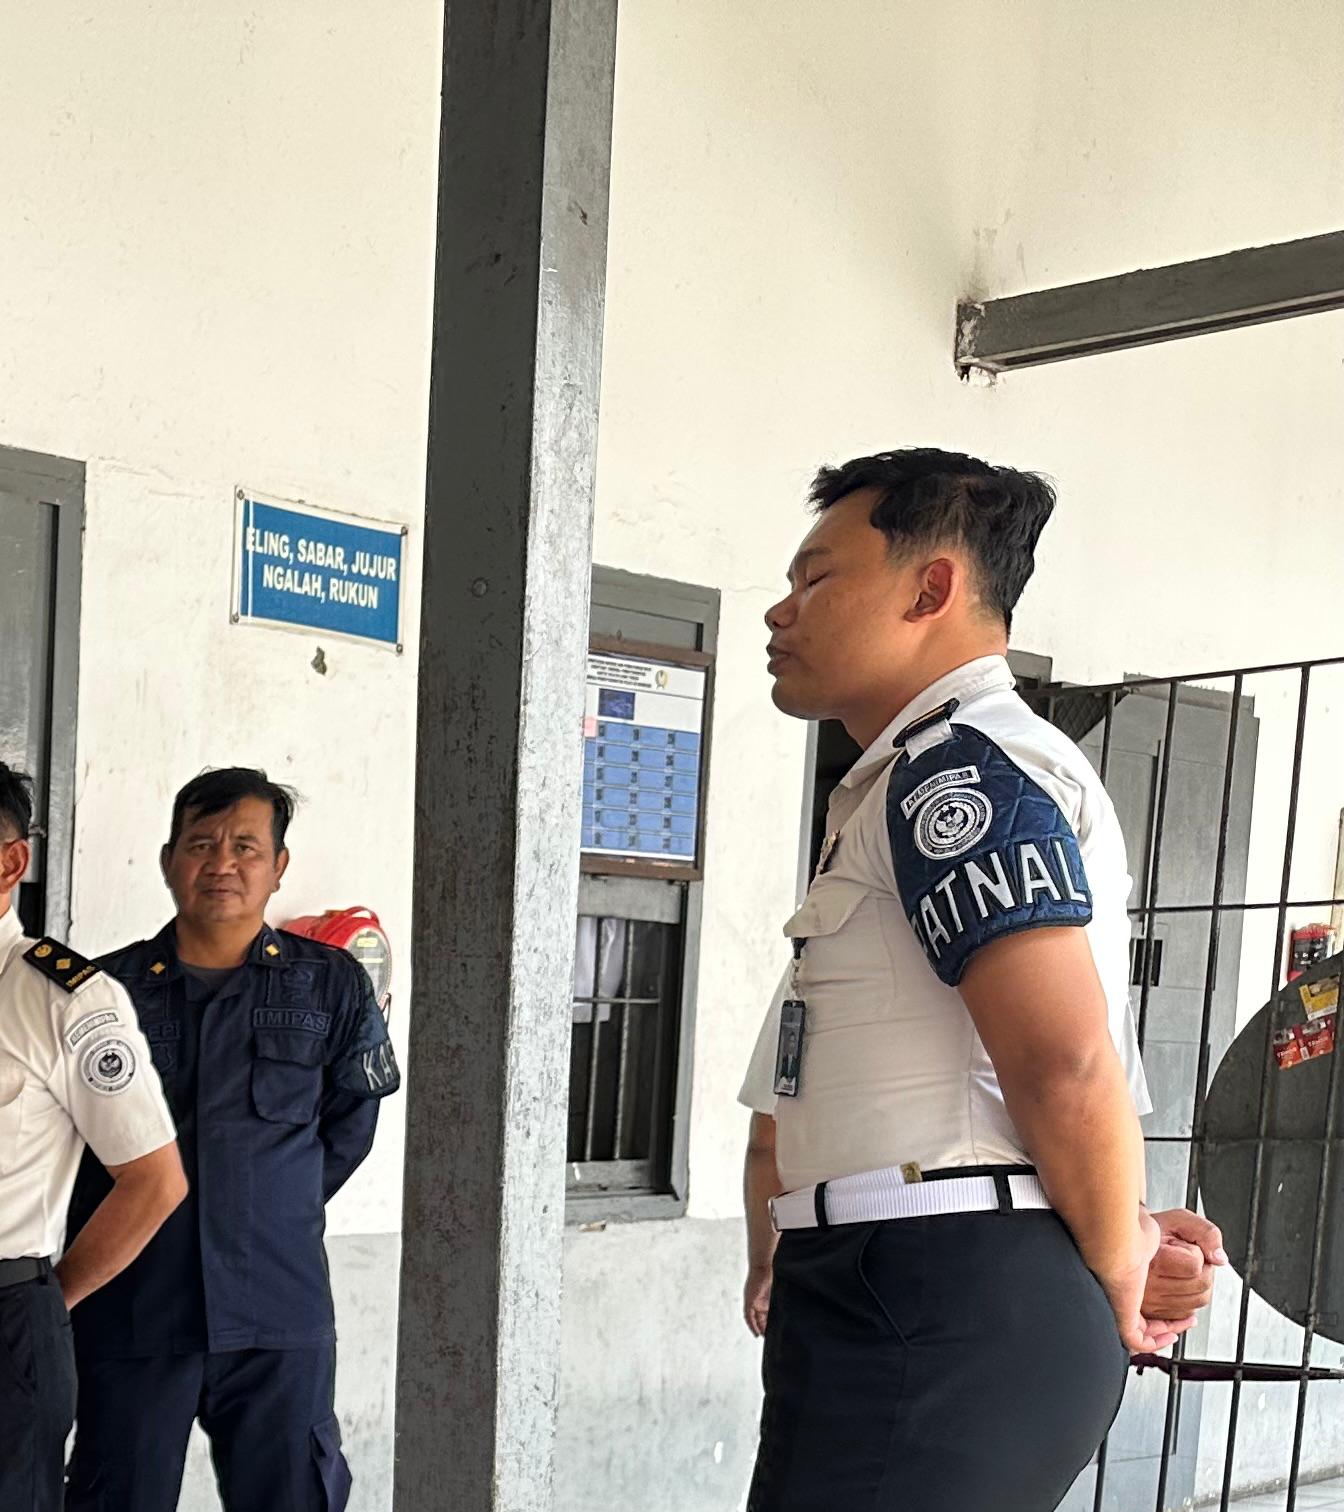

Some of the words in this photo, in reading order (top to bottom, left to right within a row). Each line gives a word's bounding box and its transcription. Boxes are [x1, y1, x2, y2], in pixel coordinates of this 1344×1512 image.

[246, 527, 293, 564] ELING,
[297, 539, 347, 575] SABAR,
[352, 550, 397, 581] JUJUR
[263, 564, 326, 603] NGALAH,
[330, 578, 379, 609] RUKUN
[257, 1010, 327, 1030] IMIPAS
